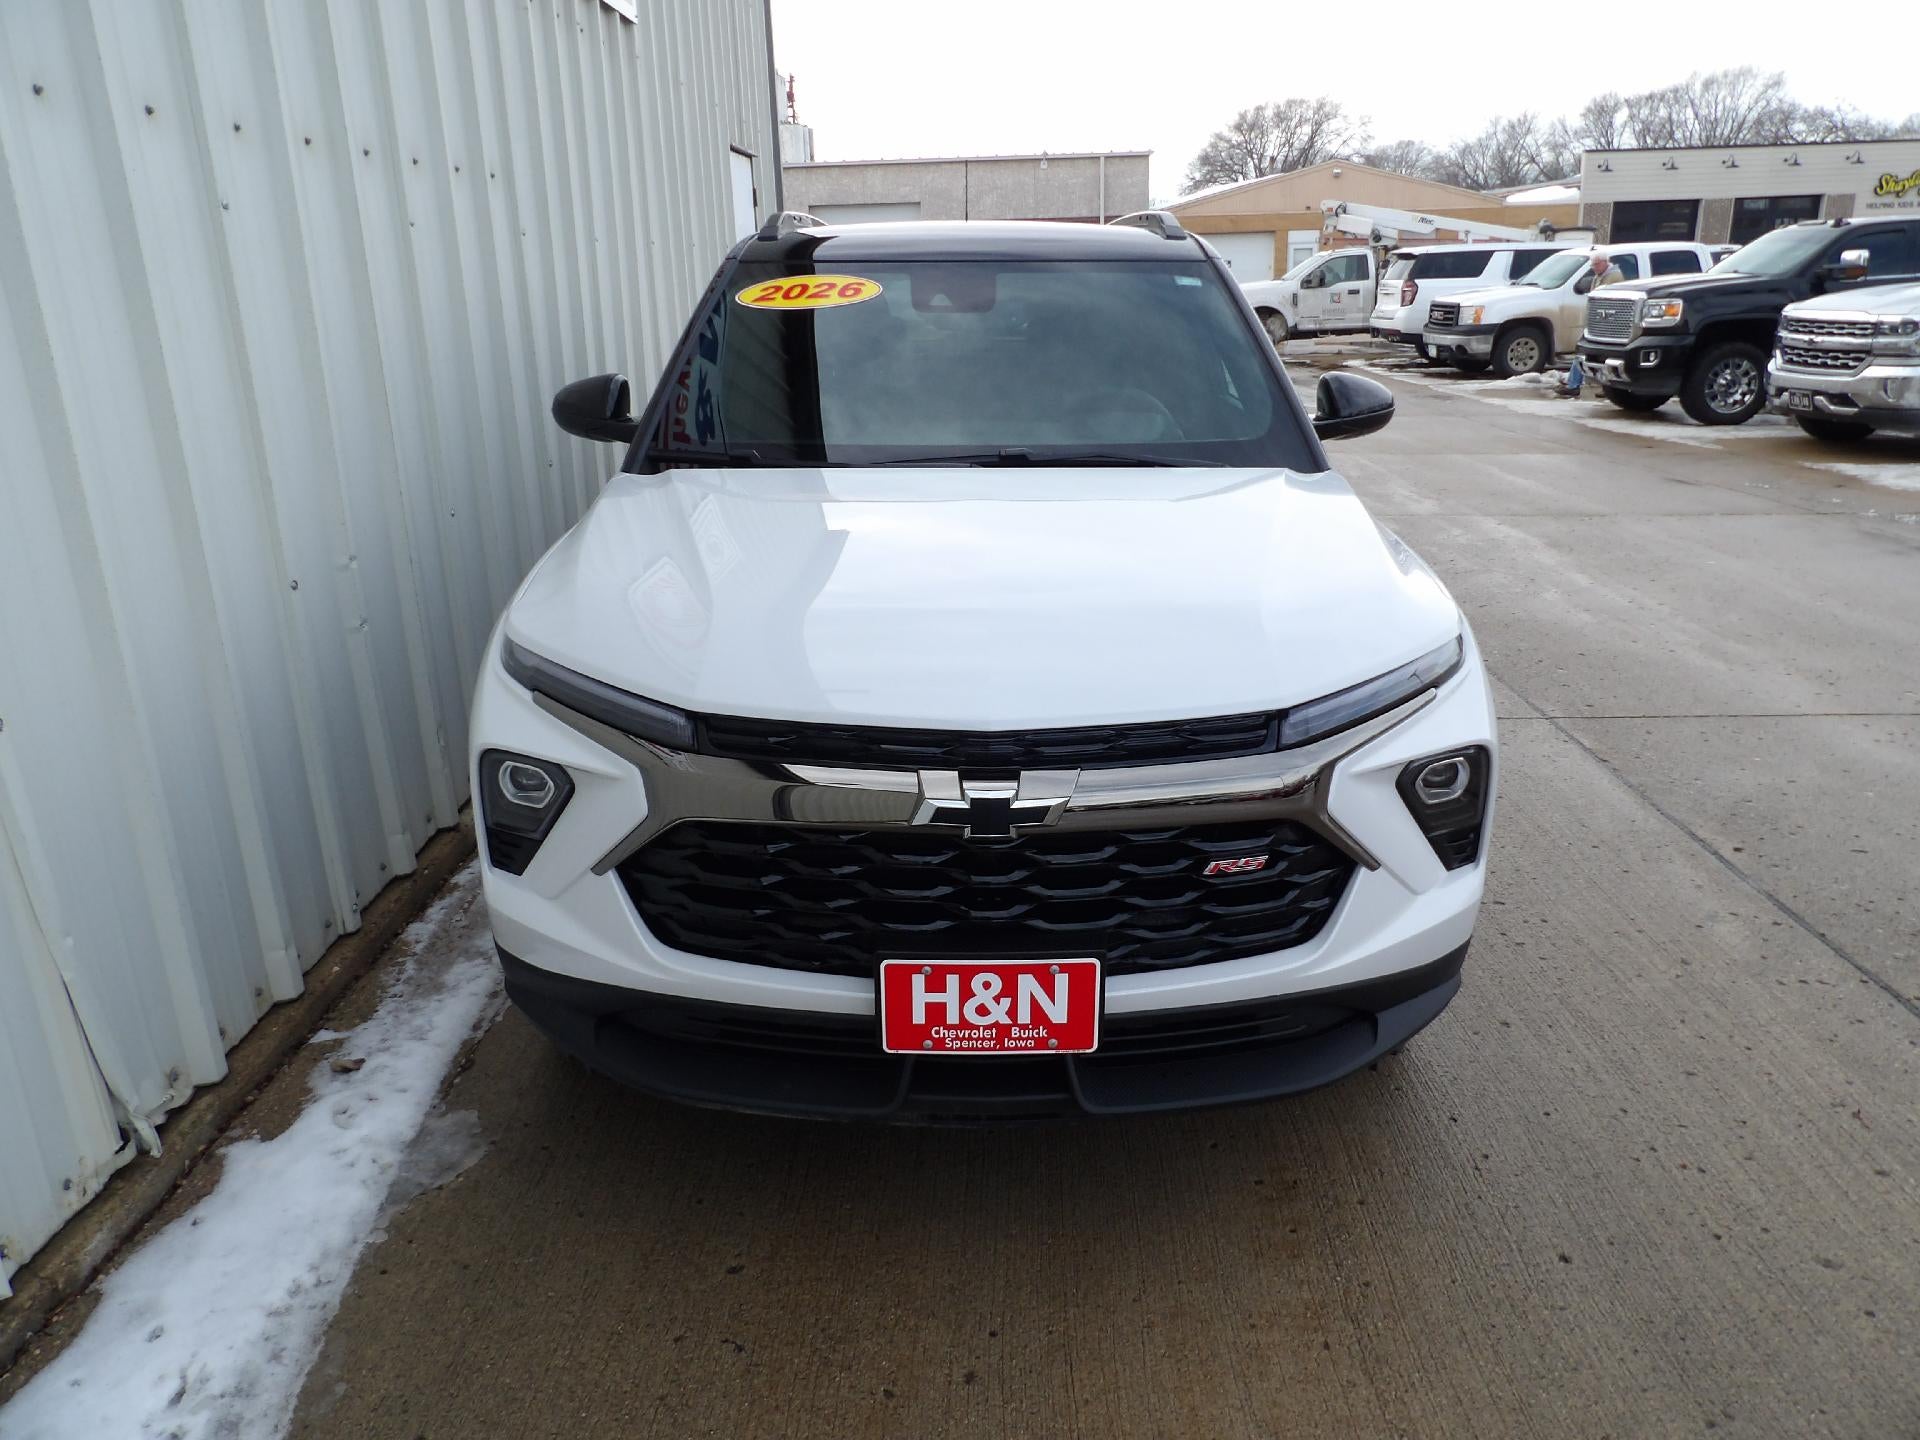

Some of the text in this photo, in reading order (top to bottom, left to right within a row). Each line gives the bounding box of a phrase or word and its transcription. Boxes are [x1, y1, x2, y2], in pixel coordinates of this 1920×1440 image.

[752, 281, 865, 303] 2026
[1203, 855, 1268, 875] RS
[911, 972, 1069, 1026] H&N
[931, 1026, 1048, 1039] Chevrolet Buick
[945, 1037, 1035, 1049] Spencer, Iowa
